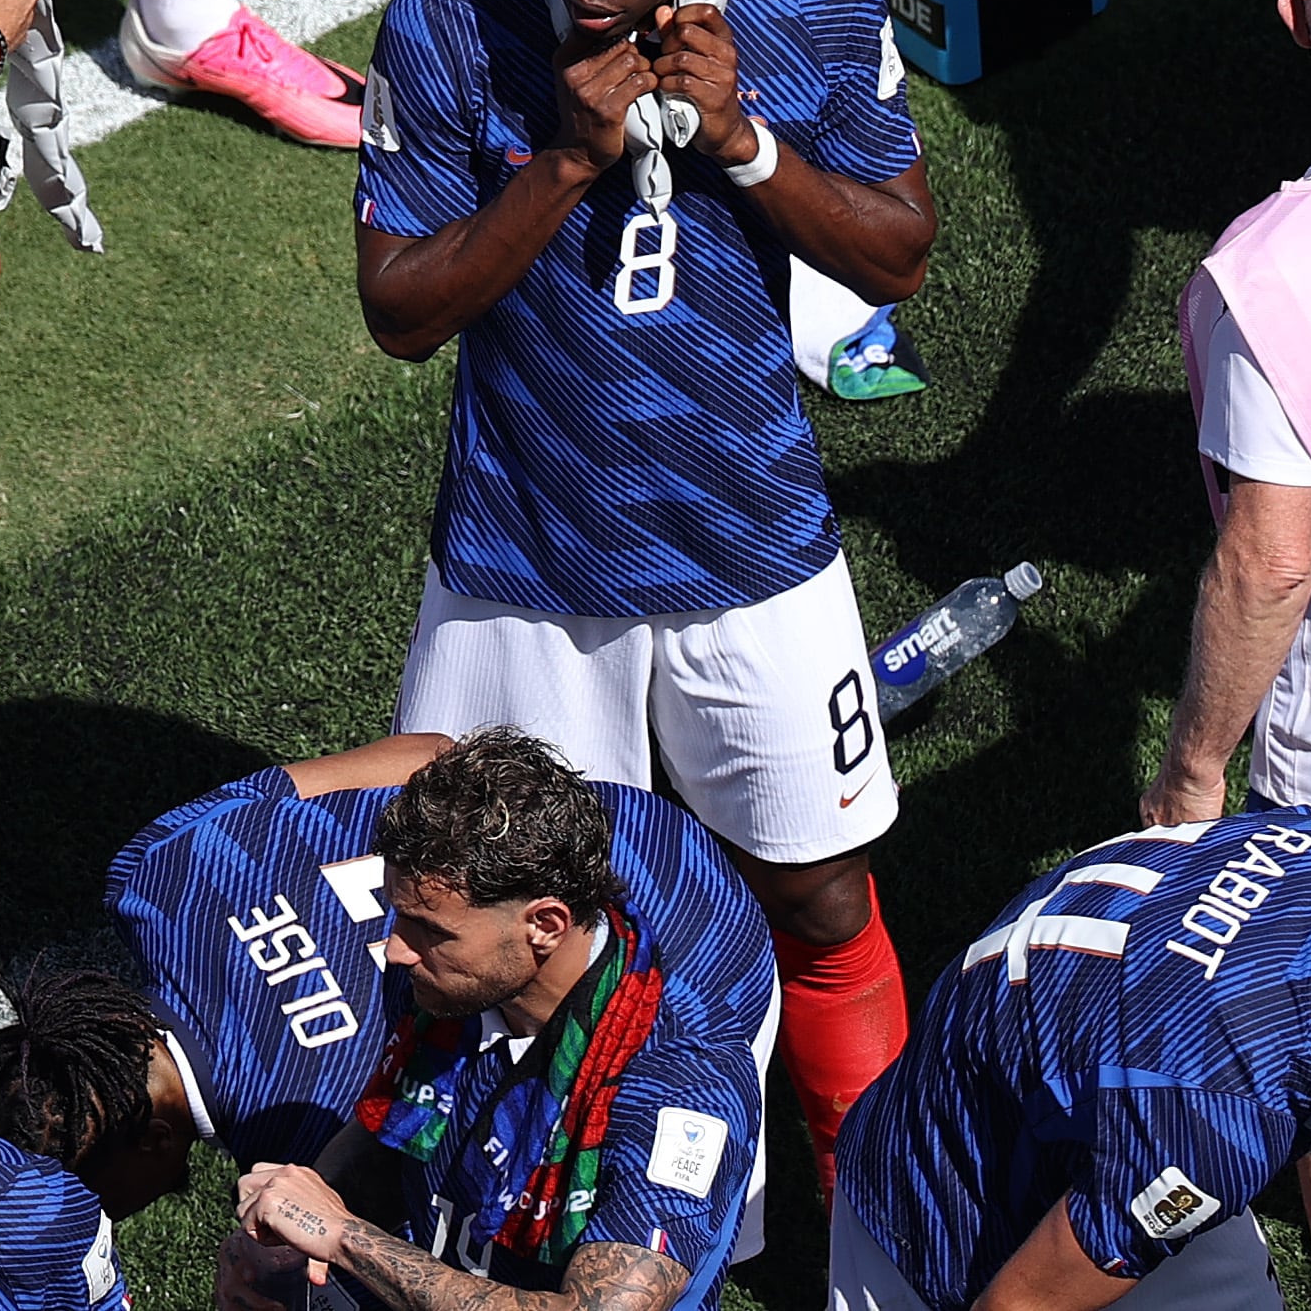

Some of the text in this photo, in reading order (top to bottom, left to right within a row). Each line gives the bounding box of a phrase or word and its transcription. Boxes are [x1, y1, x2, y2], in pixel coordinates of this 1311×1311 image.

[614, 210, 677, 315] 8
[883, 606, 958, 673] smart
[828, 668, 875, 776] 8
[227, 893, 359, 1049] OLISE
[671, 1155, 702, 1176] PEACE
